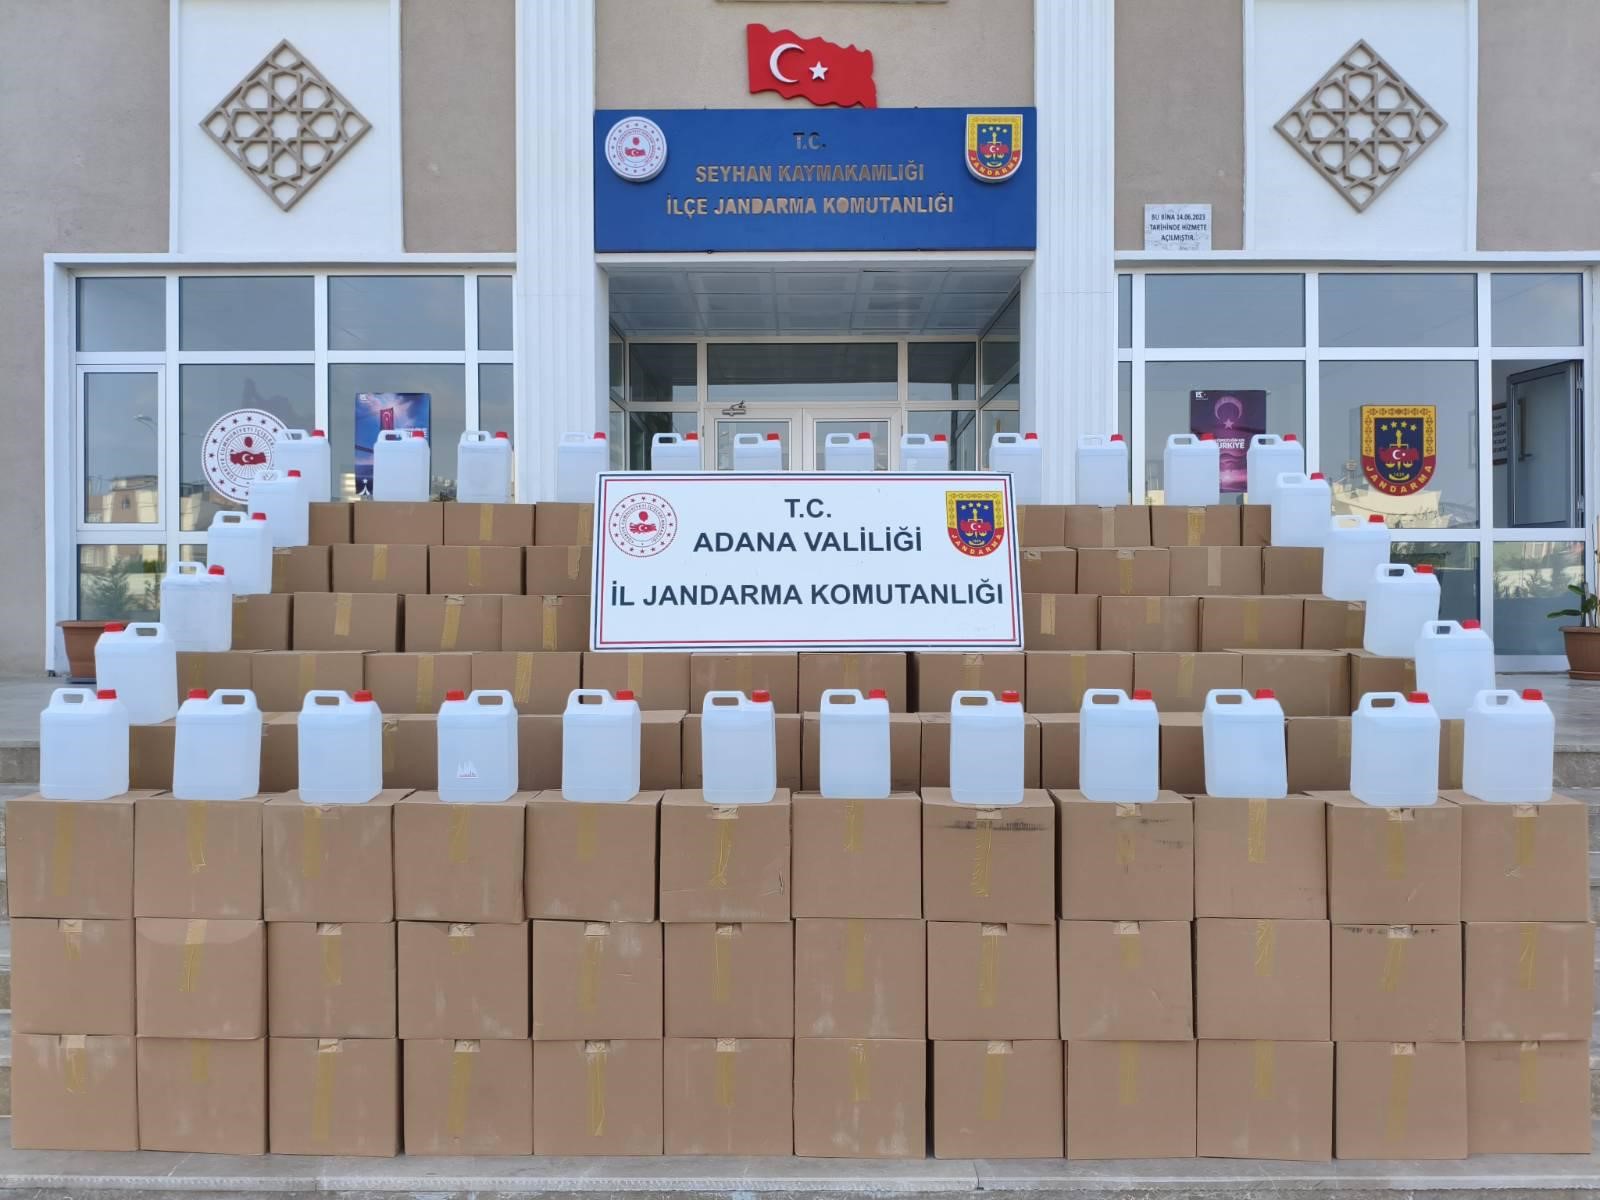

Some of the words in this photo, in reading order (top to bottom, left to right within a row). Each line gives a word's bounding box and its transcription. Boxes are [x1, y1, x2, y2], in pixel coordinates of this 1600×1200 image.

[793, 132, 827, 151] T.C.
[695, 165, 772, 182] SEYHAN
[778, 160, 925, 182] KAYMAKAMLIĞI
[666, 192, 708, 219] İLÇE
[714, 197, 817, 215] JANDARMA
[823, 192, 954, 214] KOMUTANLIĞI
[1366, 465, 1432, 494] JANDARMA
[784, 498, 832, 518] T.C.
[693, 532, 797, 552] ADANA
[804, 526, 922, 552] VALİLİĞİ
[611, 580, 635, 606] İL
[643, 584, 803, 606] JANDARMA
[811, 578, 1003, 605] KOMUTANLIĞI
